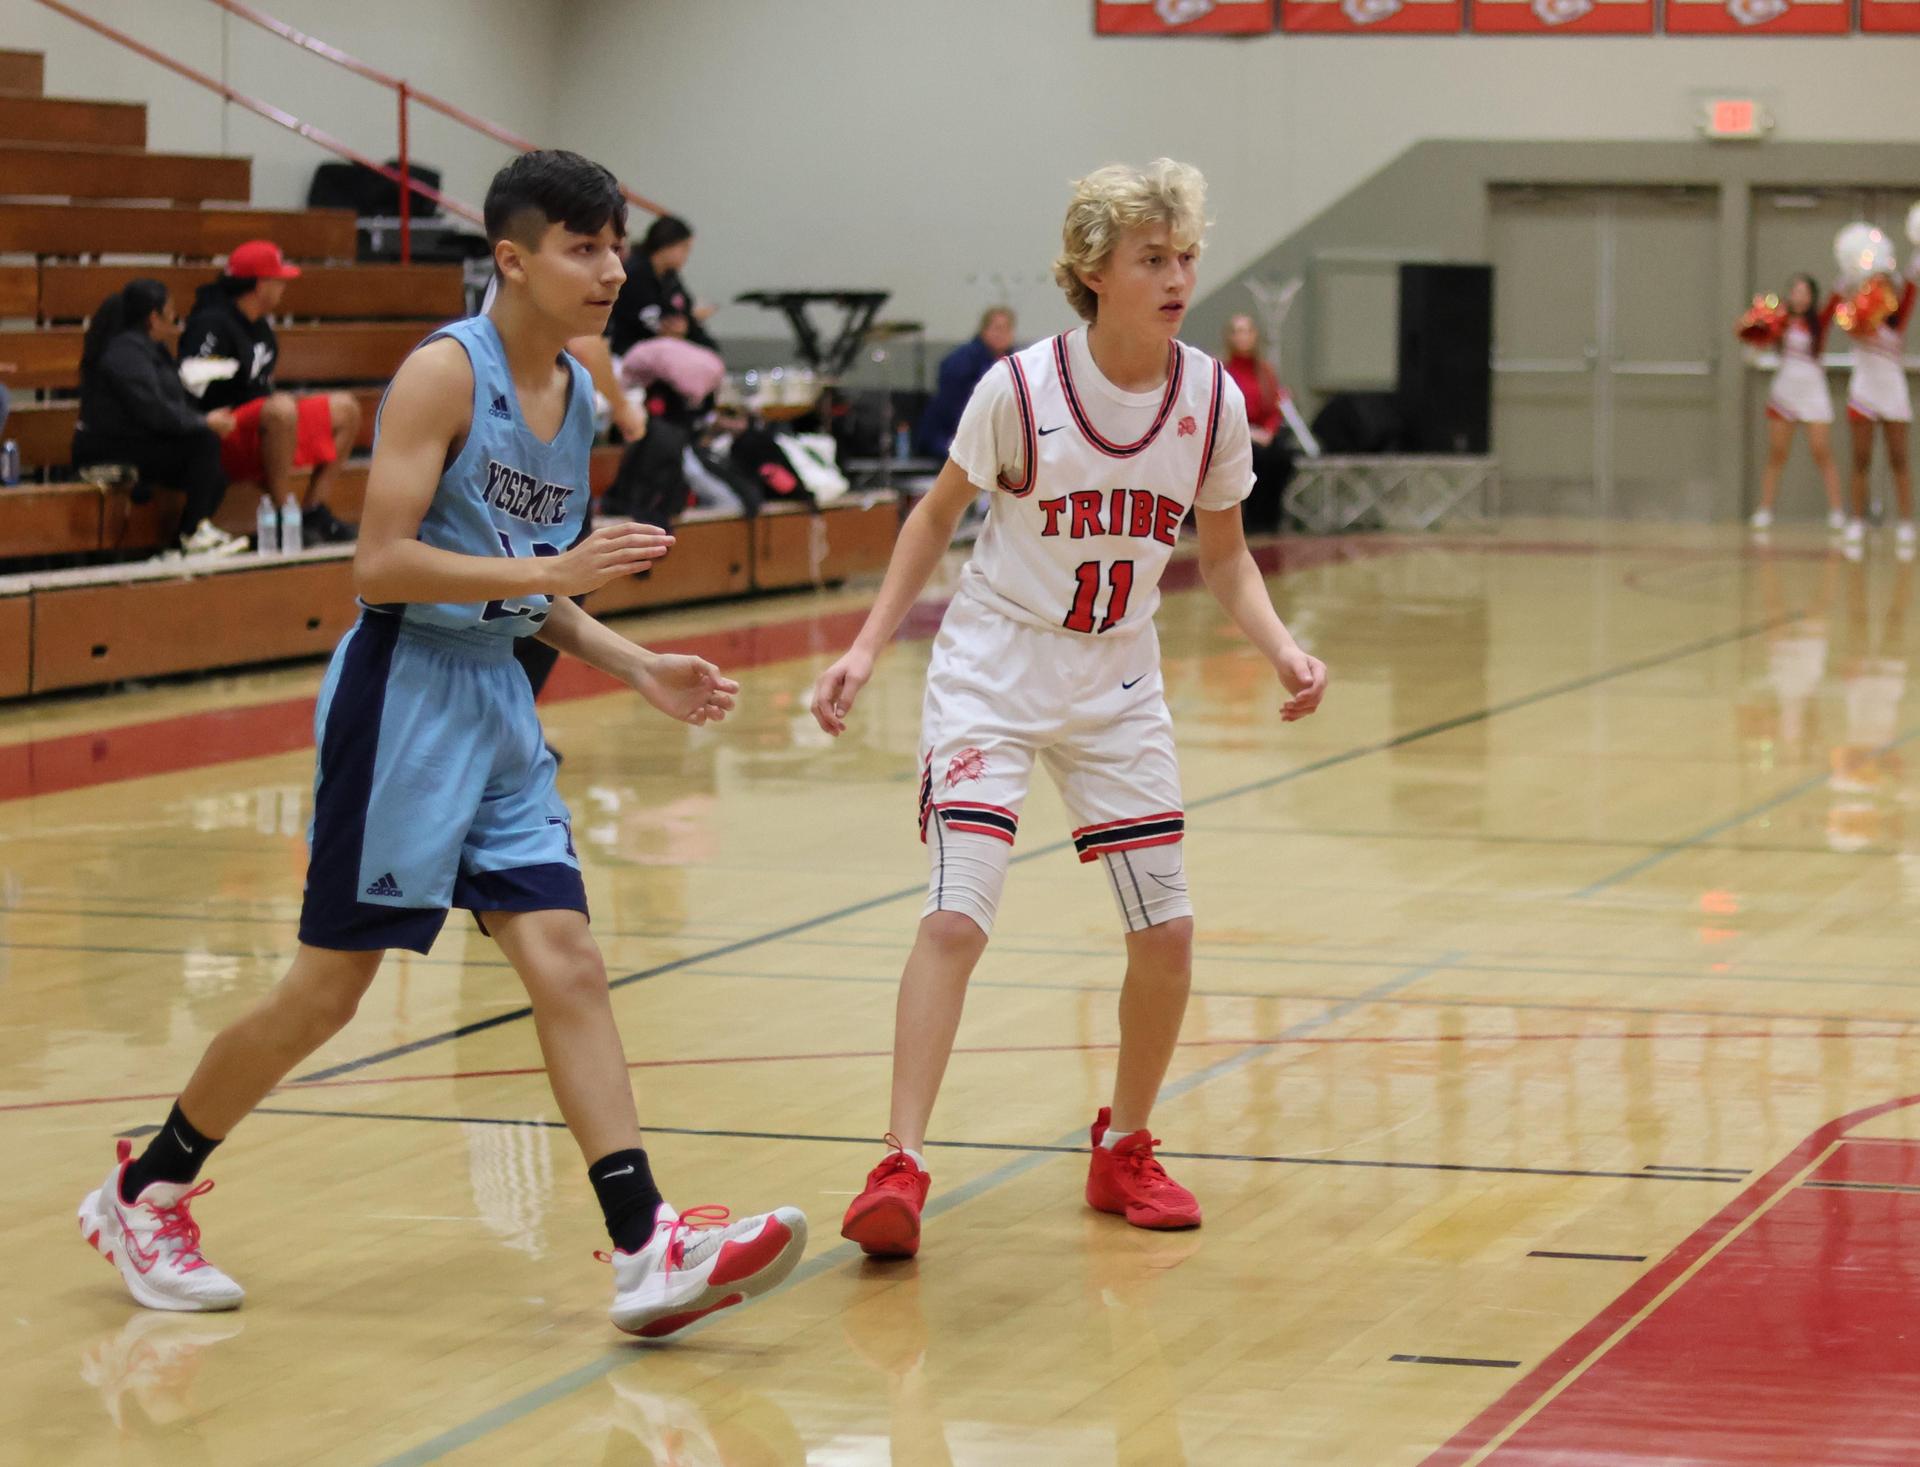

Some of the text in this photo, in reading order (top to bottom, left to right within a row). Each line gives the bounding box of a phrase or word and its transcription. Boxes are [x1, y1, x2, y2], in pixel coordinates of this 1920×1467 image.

[483, 460, 575, 526] YOSEMITE
[1038, 489, 1185, 547] TRIBE
[1062, 560, 1134, 634] 11
[366, 887, 403, 898] adidas
